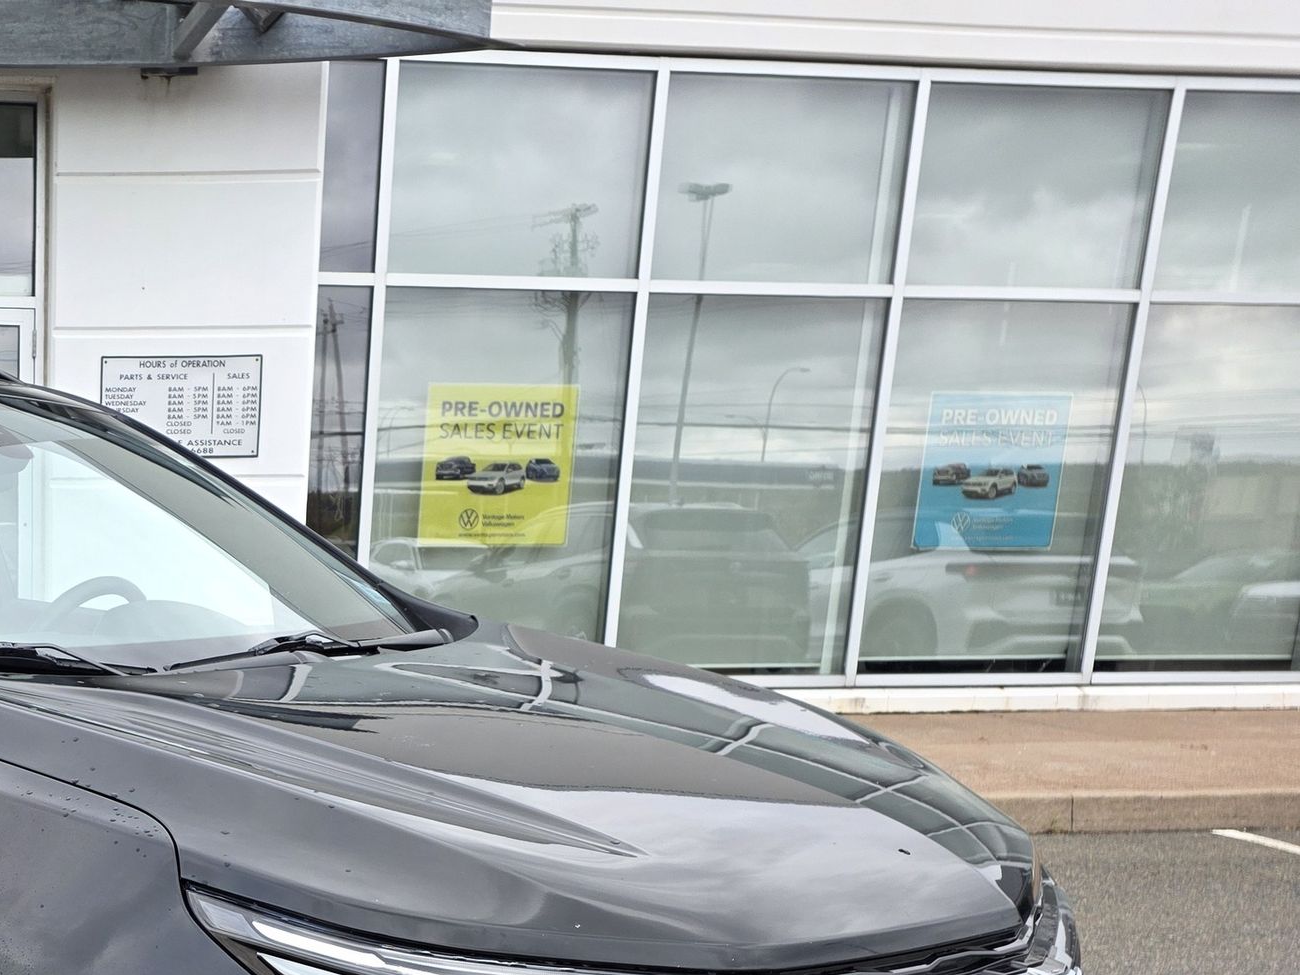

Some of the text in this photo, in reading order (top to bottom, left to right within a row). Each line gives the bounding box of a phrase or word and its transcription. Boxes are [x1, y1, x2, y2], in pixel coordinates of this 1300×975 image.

[139, 359, 226, 369] HOURS of OPERATION
[227, 372, 250, 380] SALES
[441, 401, 565, 418] PRE-OWNED
[941, 408, 1058, 426] PRE-OWNED
[439, 422, 564, 440] SALES EVENT
[939, 430, 1052, 448] SALES EVENT
